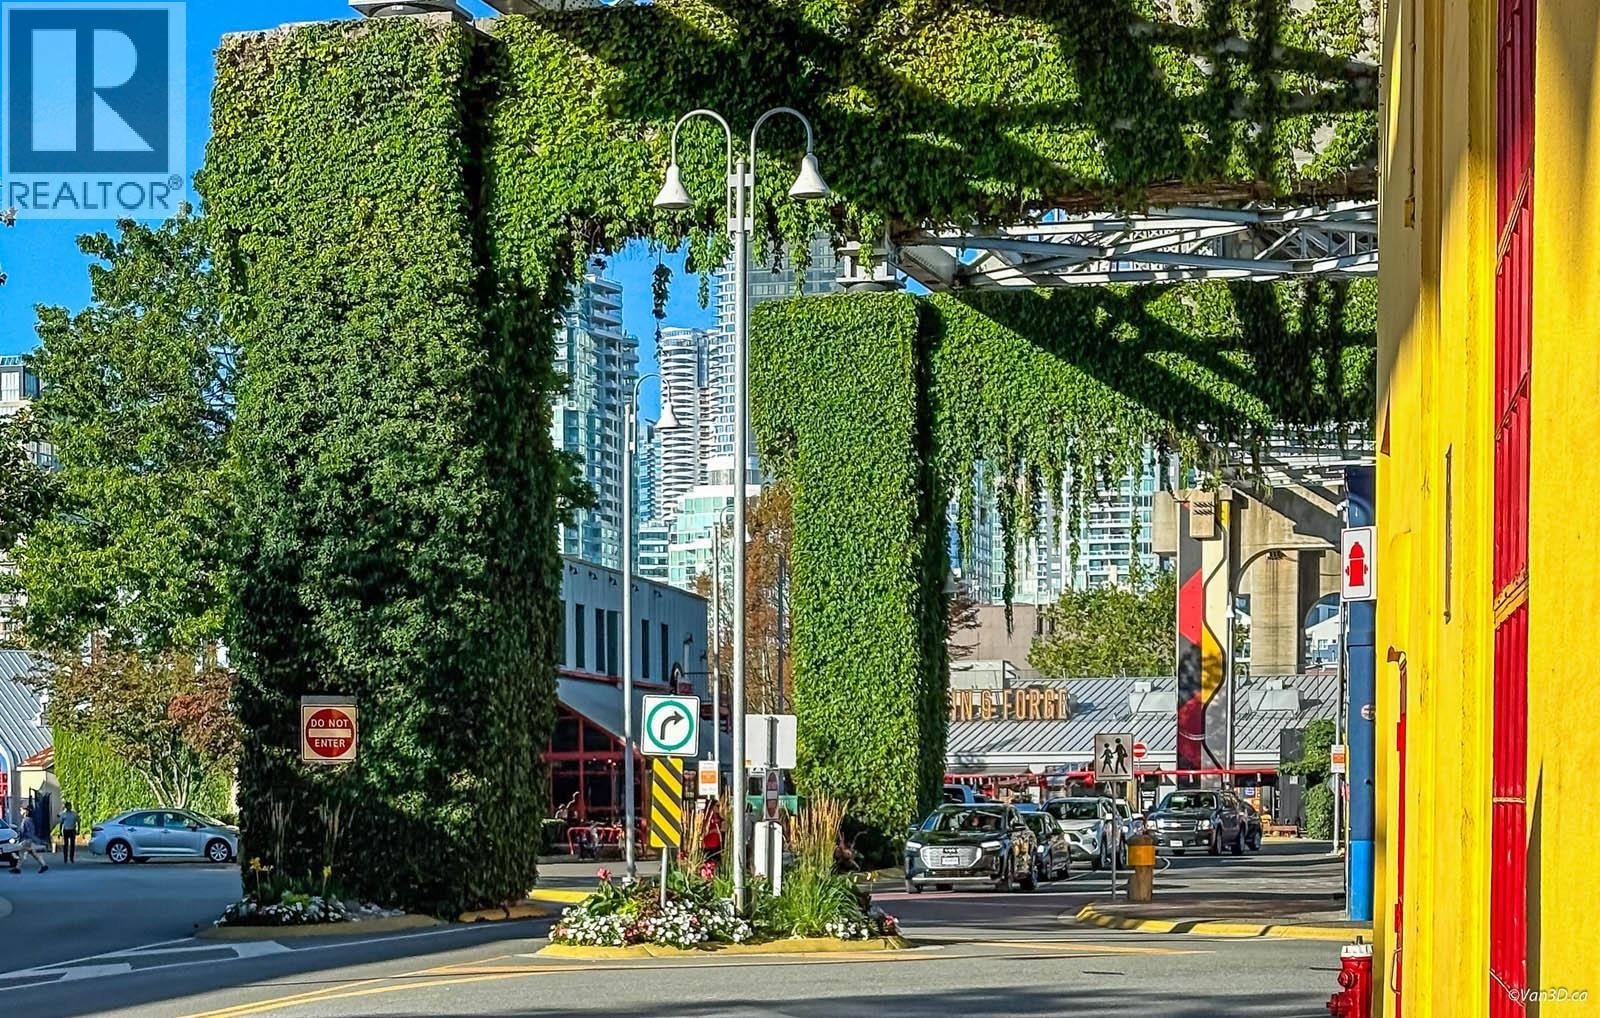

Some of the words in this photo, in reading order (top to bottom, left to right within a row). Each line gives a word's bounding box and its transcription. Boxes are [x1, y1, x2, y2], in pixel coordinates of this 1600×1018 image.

[1003, 688, 1069, 720] FORGE
[310, 719, 325, 728] DO
[328, 719, 349, 728] NOT
[314, 738, 346, 748] ENTER
